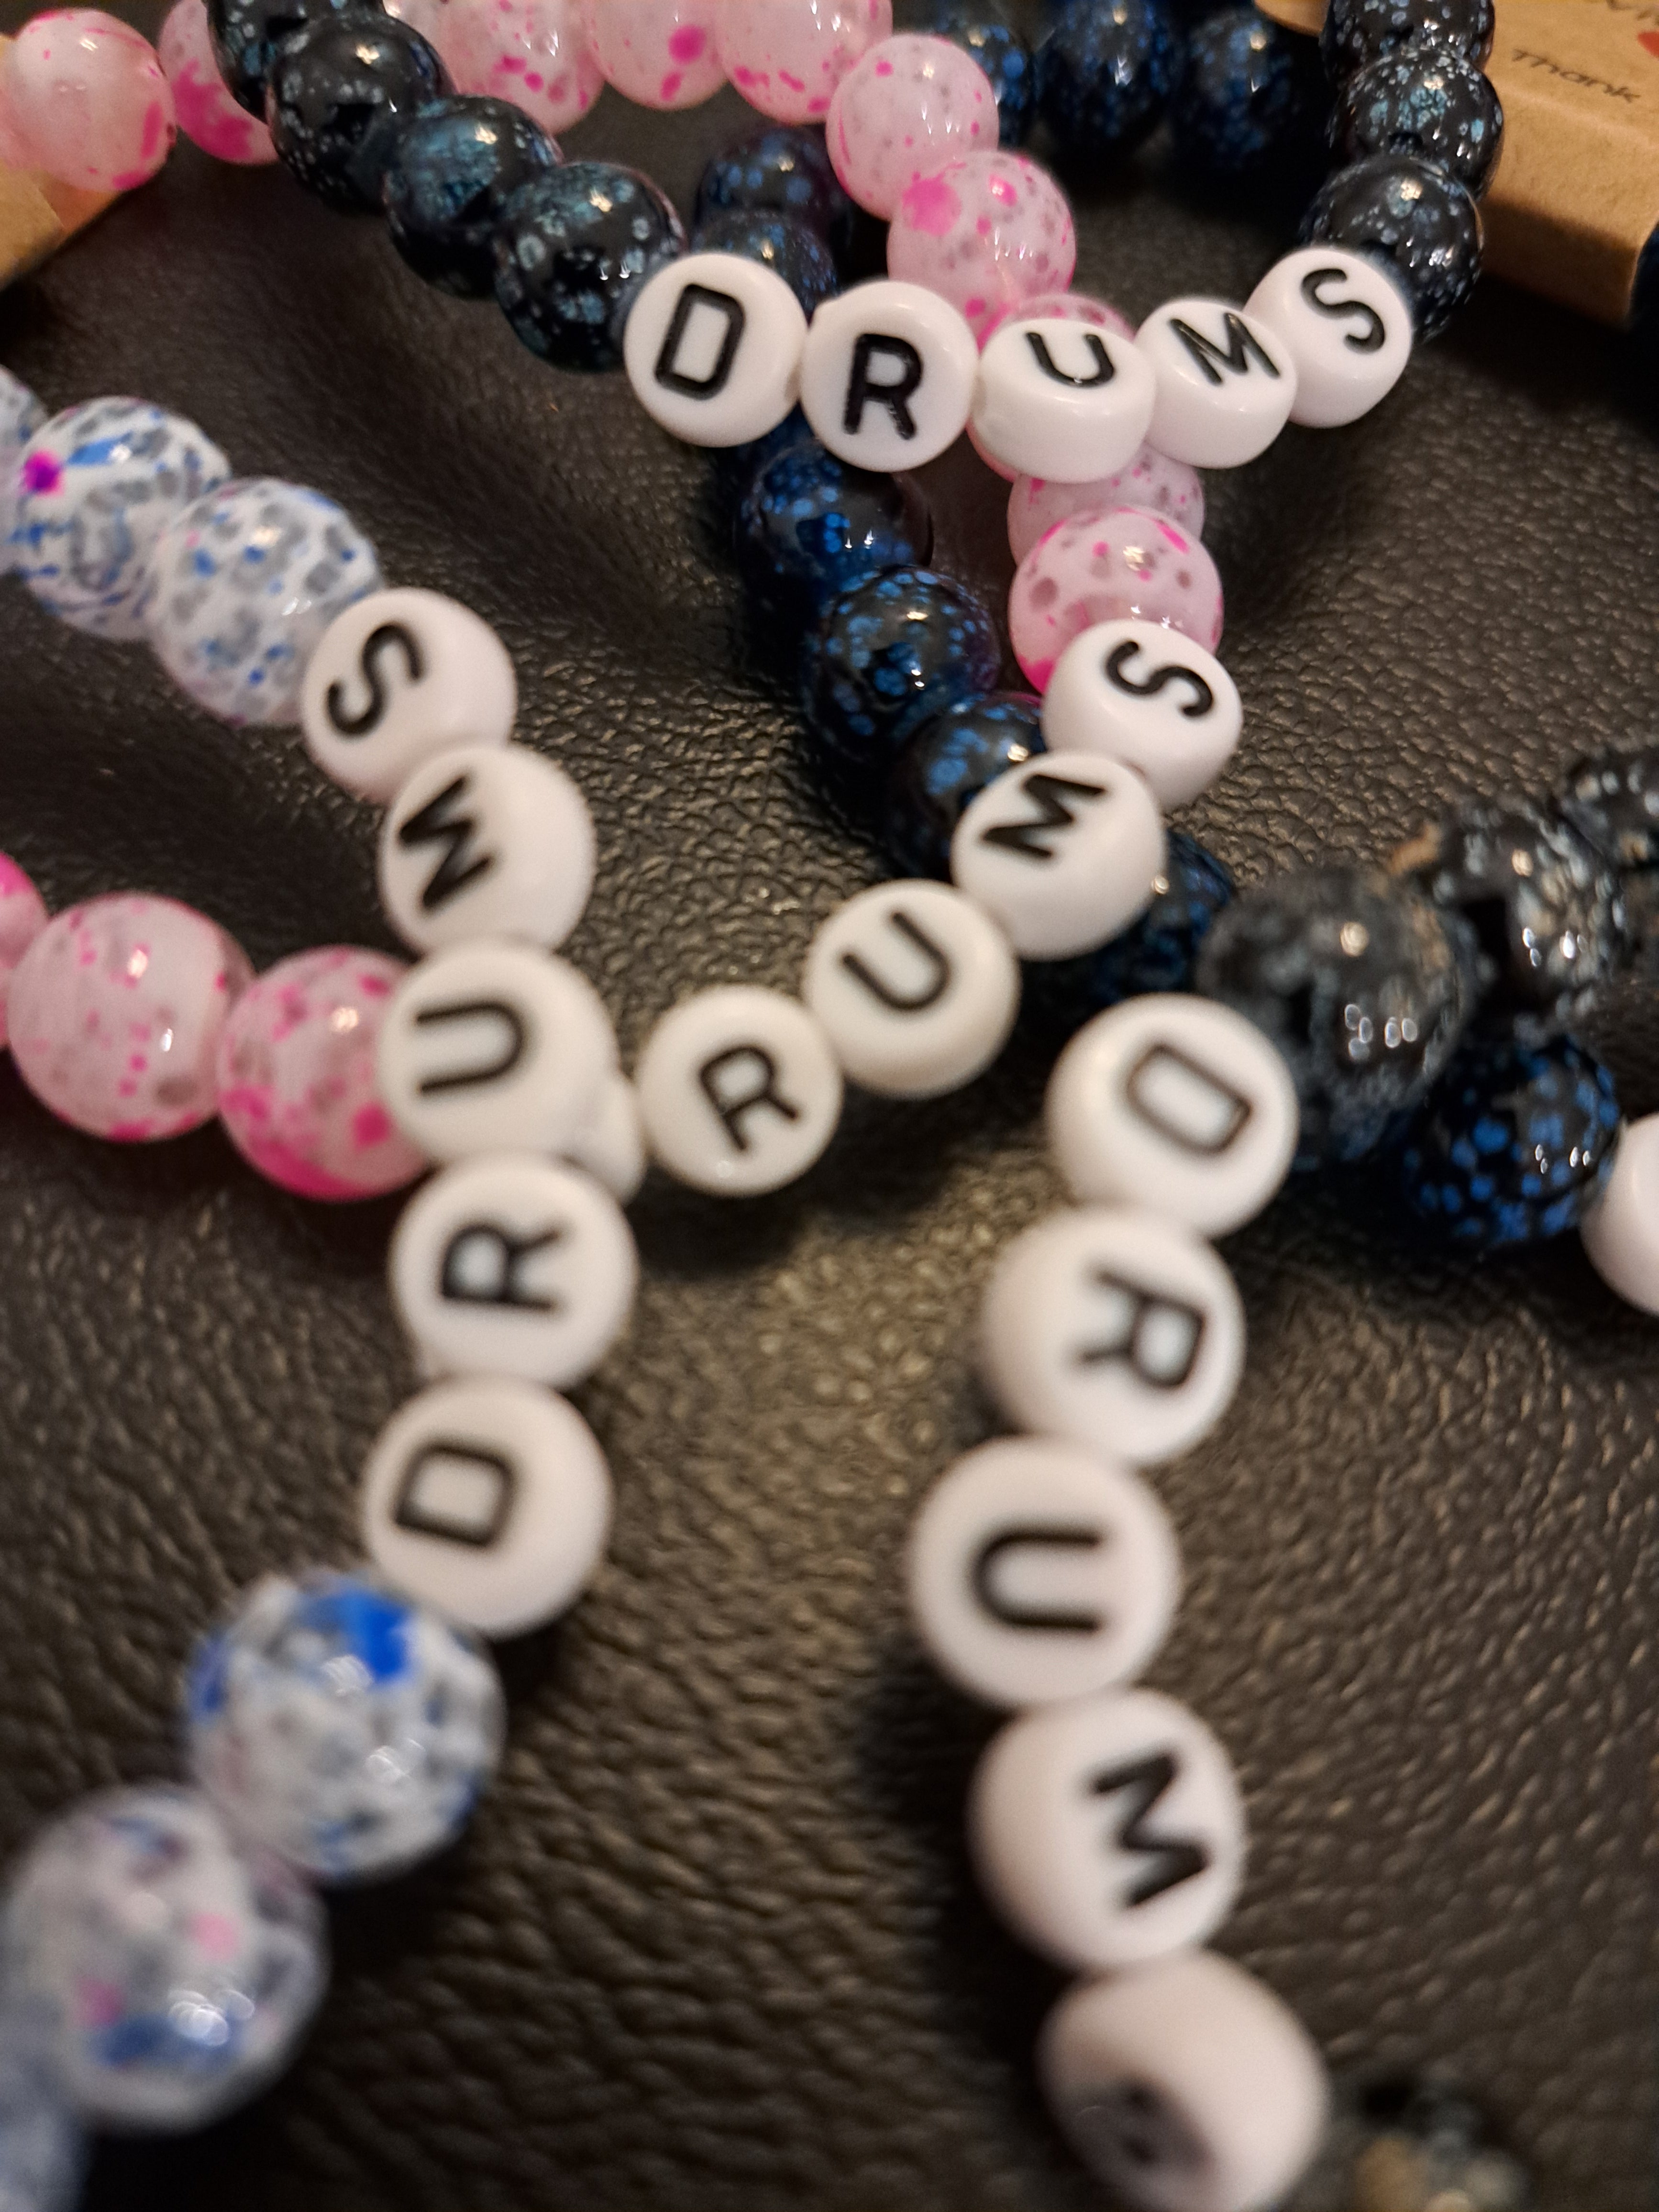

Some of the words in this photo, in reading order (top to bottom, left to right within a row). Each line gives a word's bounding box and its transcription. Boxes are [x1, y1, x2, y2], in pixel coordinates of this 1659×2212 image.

[654, 268, 1385, 440] DRUMS
[325, 621, 562, 1551] DRUMS
[698, 640, 1214, 1151] RUMS
[973, 1042, 1253, 1909] DRUM
